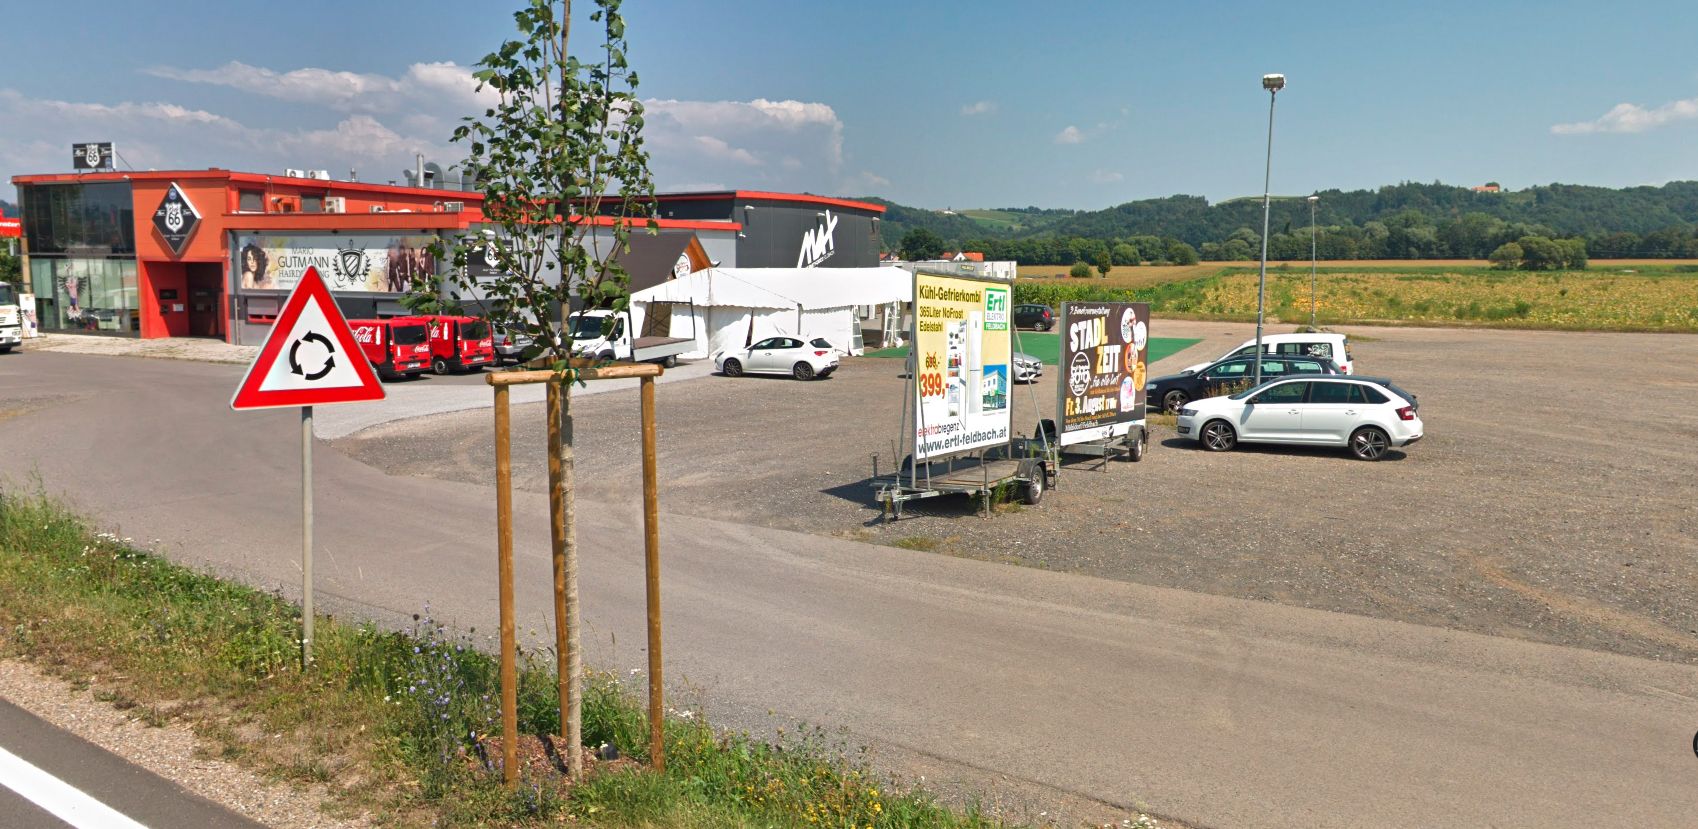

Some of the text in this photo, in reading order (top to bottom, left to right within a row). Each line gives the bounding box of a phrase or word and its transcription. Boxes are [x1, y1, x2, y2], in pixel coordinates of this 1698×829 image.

[168, 212, 180, 225] 66
[292, 247, 314, 255] MARIO
[278, 256, 329, 268] GUTMANN
[920, 285, 981, 303] Kühl-Gefrierkombi
[986, 294, 1005, 311] Ertl
[986, 312, 1005, 321] ELEKTRO
[920, 321, 943, 332] Edelstahl
[1070, 316, 1108, 352] STADL
[1096, 345, 1121, 374] ZEIT
[1082, 395, 1105, 415] August
[918, 427, 1006, 454] www.ertl-feldbach.at
